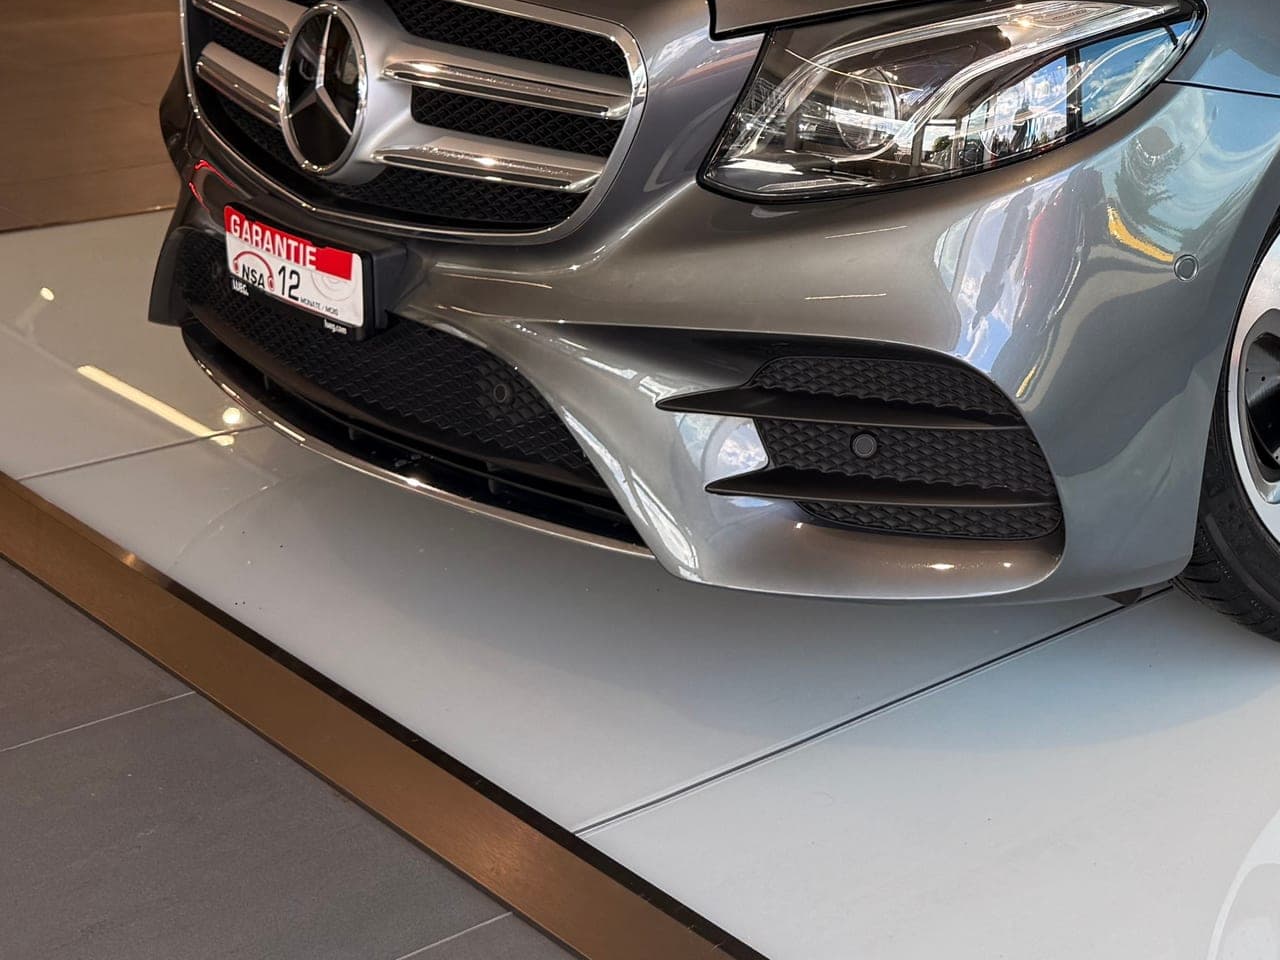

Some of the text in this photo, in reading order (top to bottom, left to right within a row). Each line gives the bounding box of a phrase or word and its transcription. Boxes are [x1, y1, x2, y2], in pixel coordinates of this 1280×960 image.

[230, 214, 318, 270] GARANTIE
[241, 263, 266, 289] NSA
[278, 265, 301, 302] 12
